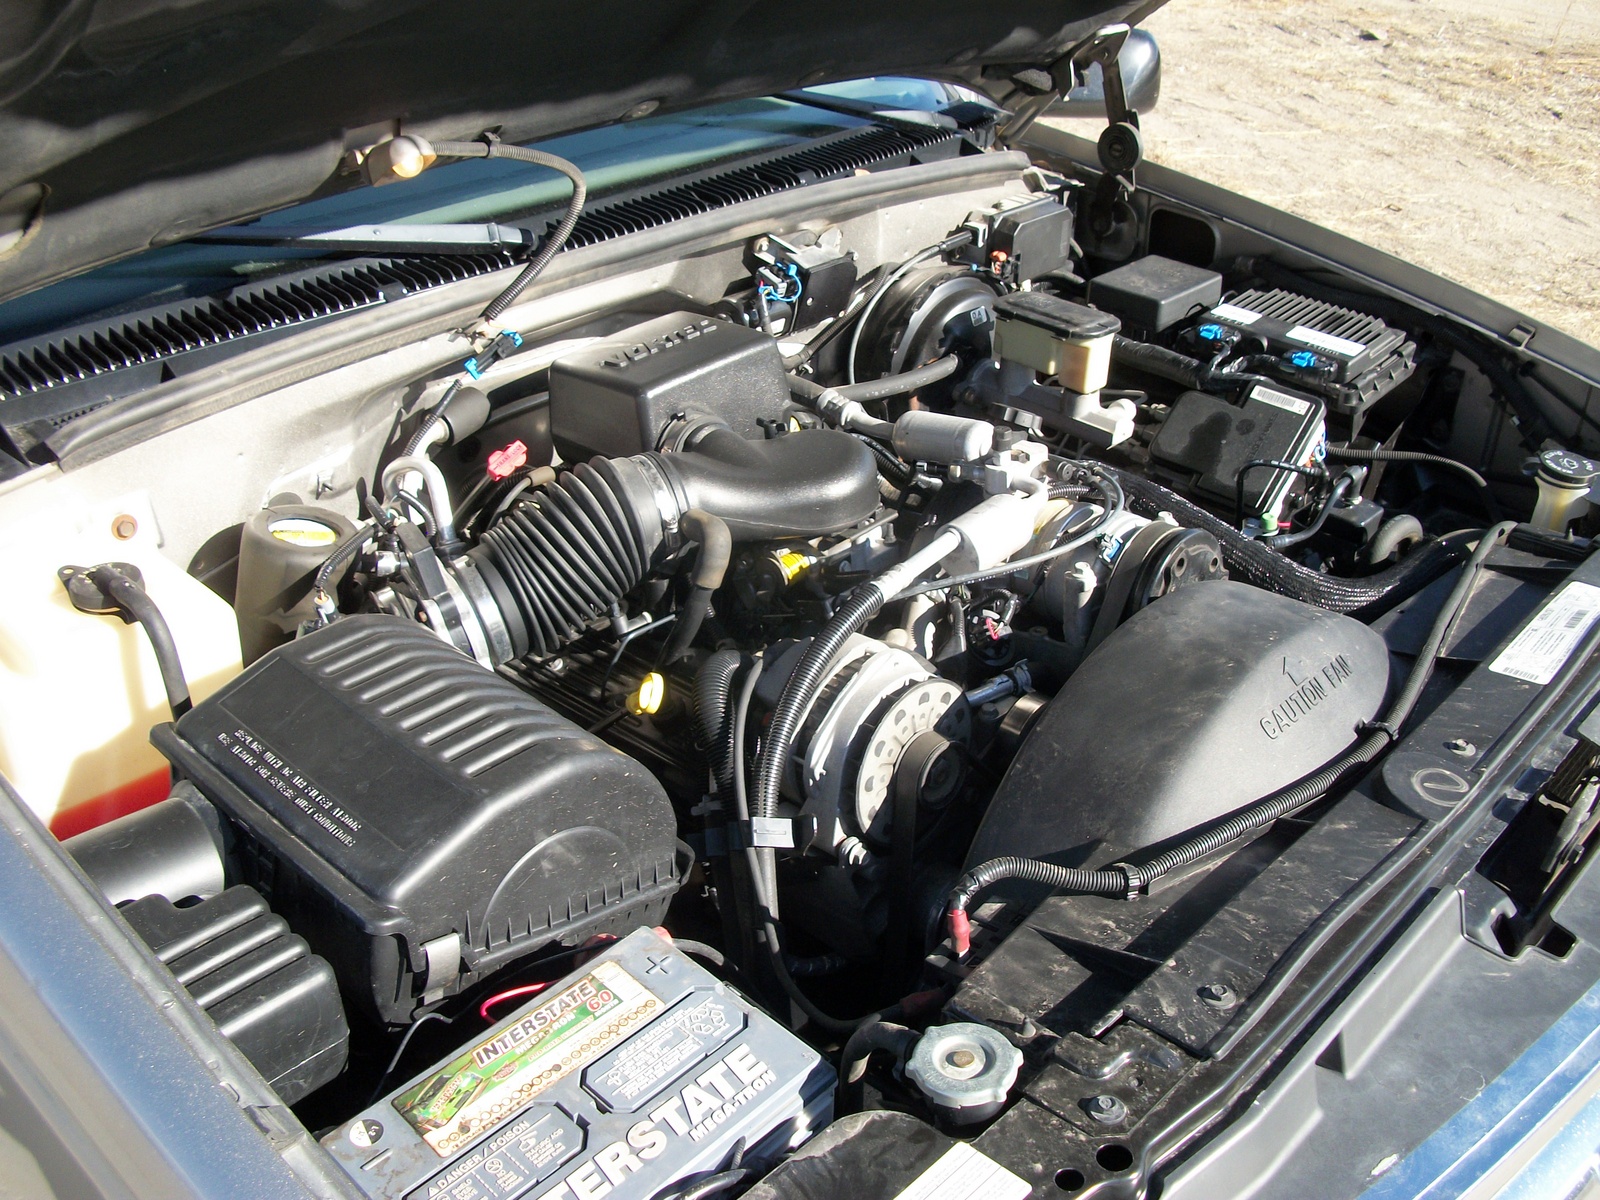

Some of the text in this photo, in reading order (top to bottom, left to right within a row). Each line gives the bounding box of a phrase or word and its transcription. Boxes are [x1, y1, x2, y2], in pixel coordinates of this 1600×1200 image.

[1259, 654, 1353, 741] CAUTION FAN
[475, 981, 594, 1065] INTERSTATE
[587, 990, 613, 1012] 60
[688, 1069, 777, 1142] MEGA-TRON
[436, 1152, 482, 1189] DANGER
[488, 1119, 530, 1151] POISON
